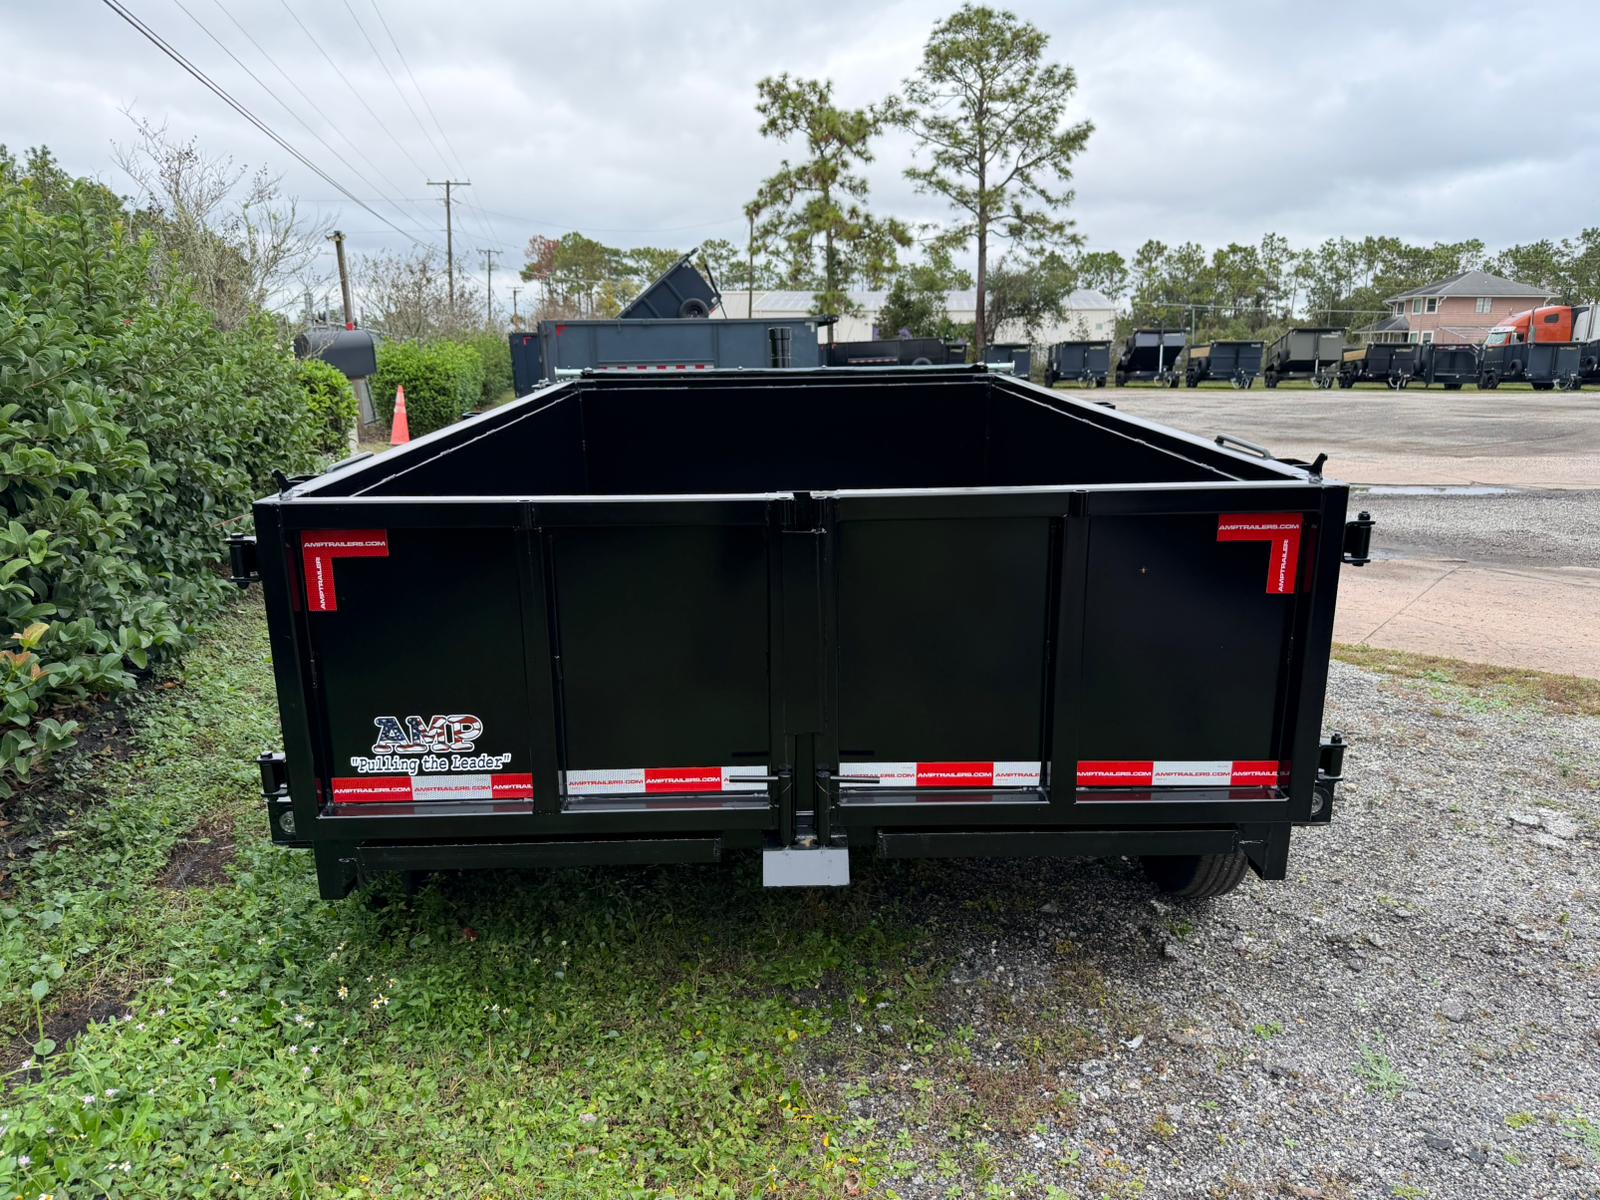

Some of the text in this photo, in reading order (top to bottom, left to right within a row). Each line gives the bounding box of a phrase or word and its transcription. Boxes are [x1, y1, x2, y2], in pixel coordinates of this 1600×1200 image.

[372, 715, 484, 754] AMP
[350, 753, 512, 775] "Pulling the Leader"
[645, 776, 720, 784] AMPTRAILERS.COM
